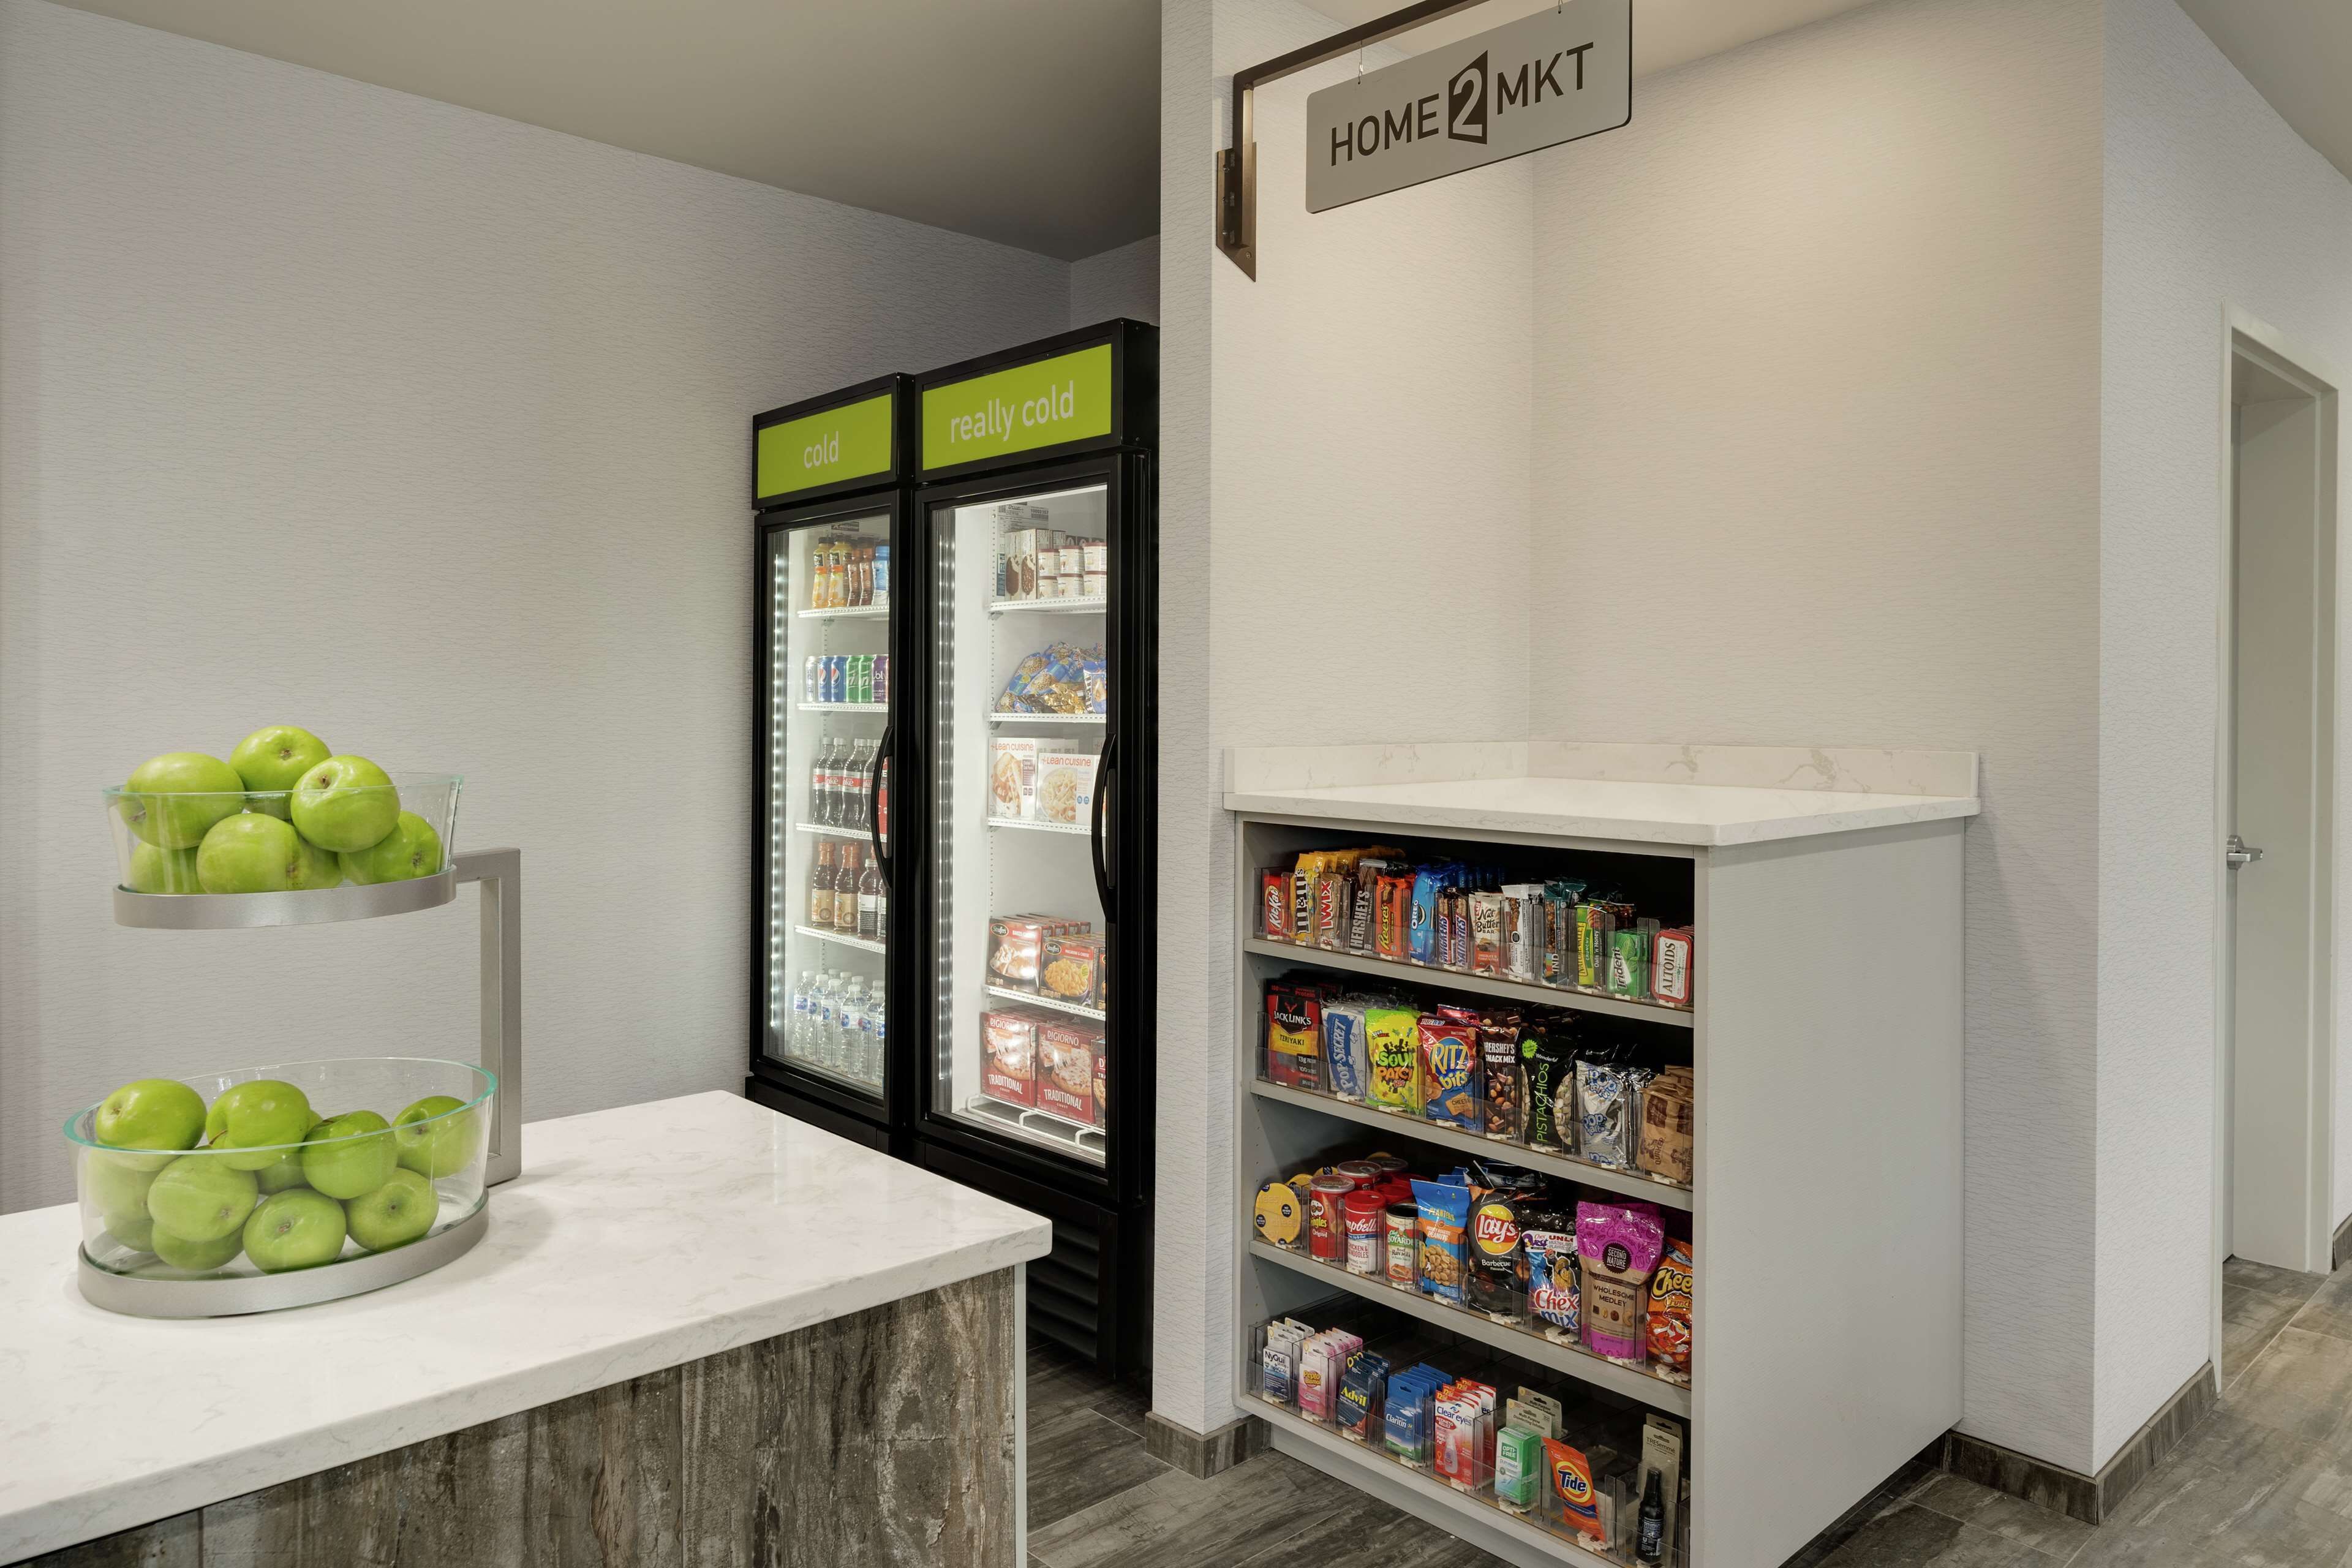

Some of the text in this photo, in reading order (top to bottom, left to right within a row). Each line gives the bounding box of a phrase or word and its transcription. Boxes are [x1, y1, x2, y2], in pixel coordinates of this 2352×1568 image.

[950, 380, 1074, 443] really cold
[803, 431, 840, 469] cold
[1011, 743, 1034, 752] cuisine
[1065, 758, 1091, 767] cuisine
[1349, 890, 1370, 948] HERSHEY'S
[1478, 908, 1494, 920] Nut
[1476, 921, 1499, 933] Butter
[1662, 942, 1676, 993] ALTOIDS
[990, 1018, 1018, 1031] DIGIOR
[1273, 1011, 1312, 1025] JACK LINK'S
[1280, 1034, 1305, 1046] TERIYAKI
[1431, 1043, 1468, 1074] RITZ
[1535, 1053, 1558, 1063] Wonderful
[988, 1074, 1023, 1095] TRADITIONAL
[1439, 1071, 1468, 1090] bits
[1044, 1089, 1082, 1110] TRADITIONAL
[1536, 1063, 1549, 1142] PISTACHIOS
[1655, 1137, 1665, 1165] QUAKER
[1478, 1215, 1517, 1243] Lay's
[1607, 1256, 1626, 1268] NATURE
[1608, 1248, 1627, 1260] SECOND
[1652, 1267, 1692, 1300] Chee
[1535, 1289, 1579, 1312] Chex
[1593, 1284, 1635, 1302] WHOLESOME
[1599, 1294, 1627, 1307] MEDLEY
[1665, 1298, 1692, 1308] Crunch
[1265, 1351, 1286, 1364] NyQui
[1303, 1370, 1320, 1380] Pepto
[1340, 1386, 1367, 1408] Advil
[1385, 1413, 1407, 1428] Claritin
[1436, 1406, 1455, 1419] Clear
[1455, 1414, 1472, 1427] eyes
[1558, 1469, 1586, 1492] Tide
